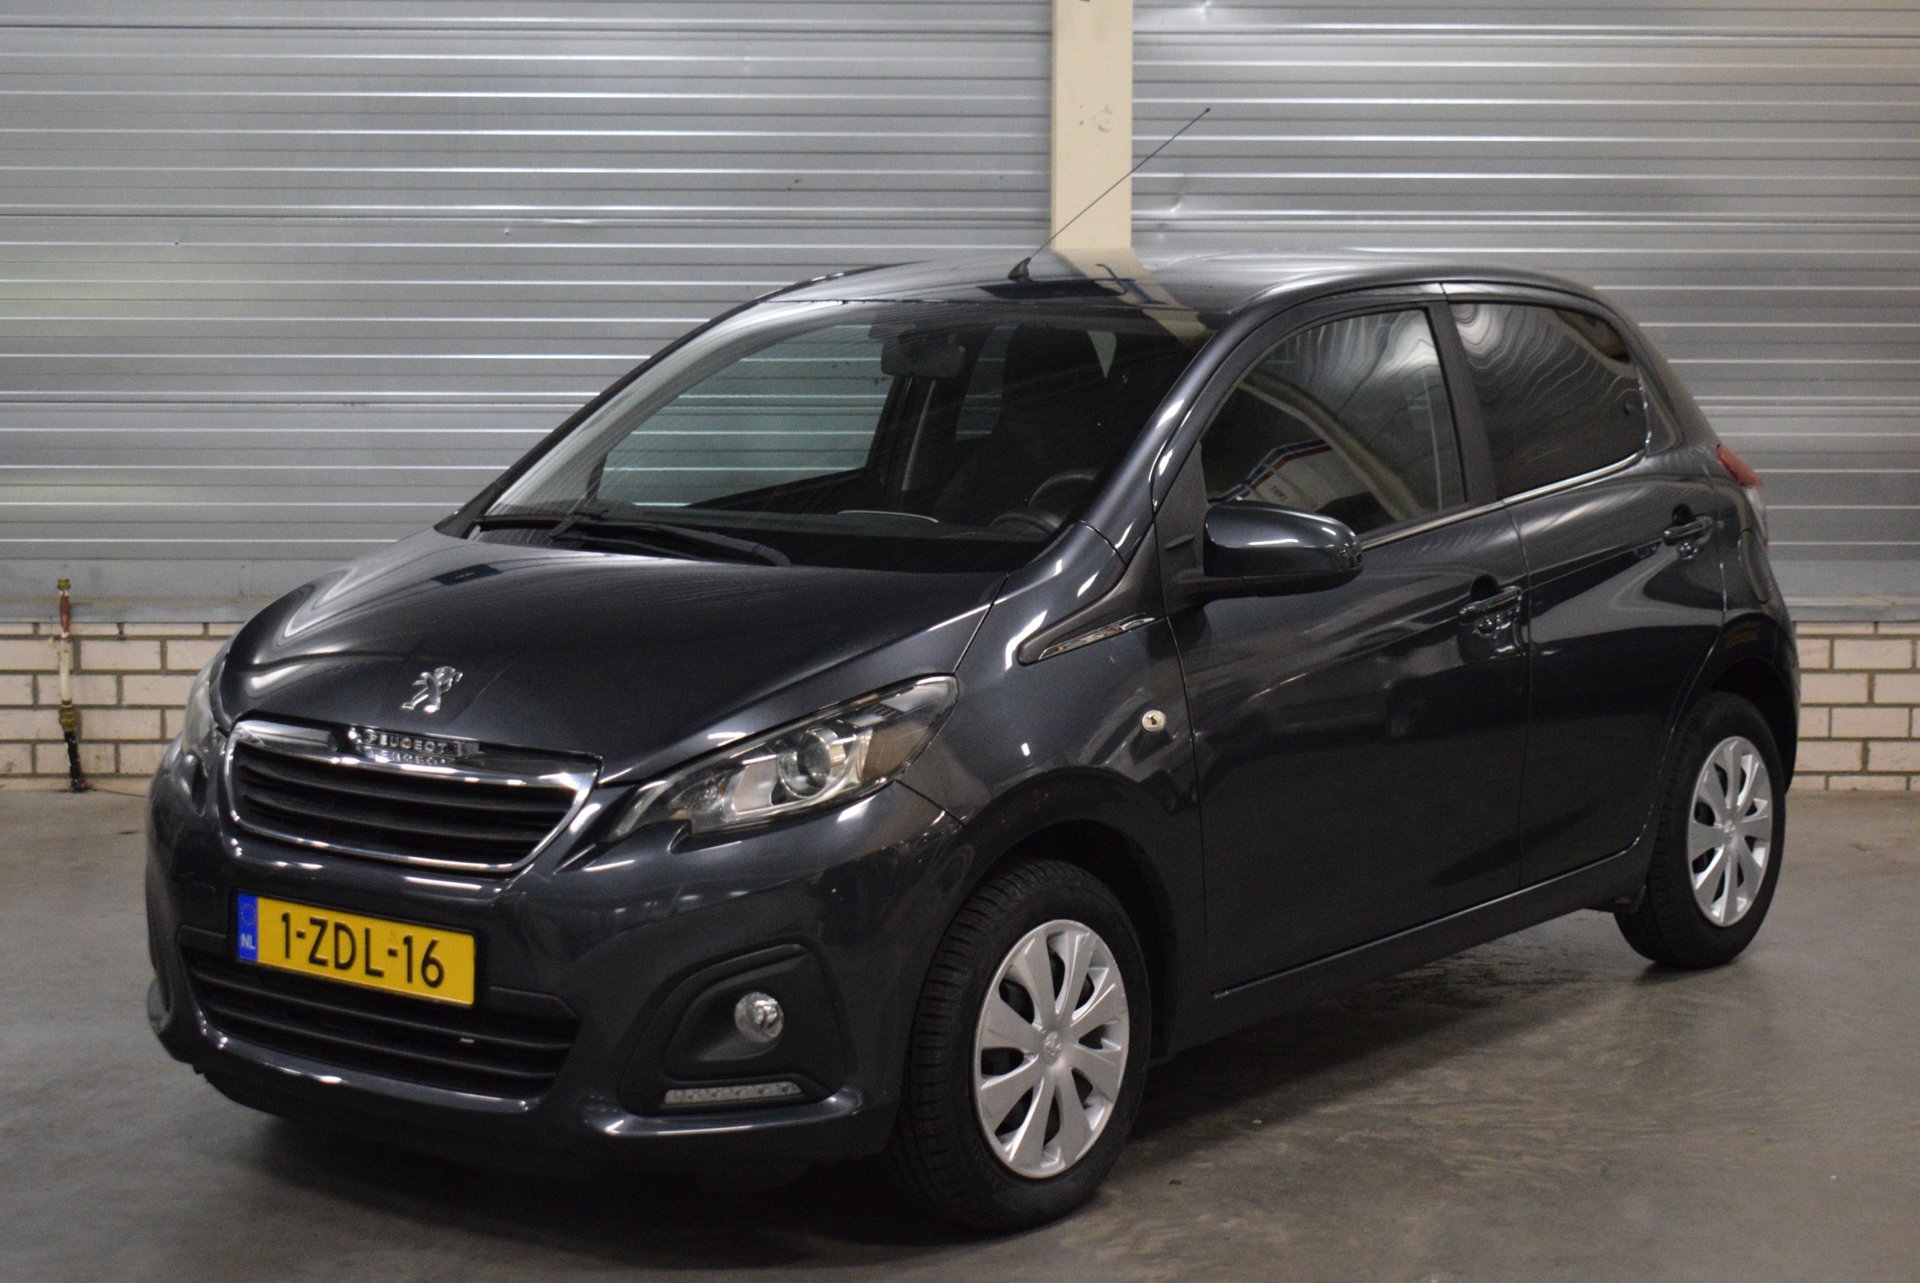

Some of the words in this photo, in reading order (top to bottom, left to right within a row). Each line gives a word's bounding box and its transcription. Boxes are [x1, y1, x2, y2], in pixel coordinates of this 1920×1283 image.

[366, 731, 447, 753] PEUGEOT
[240, 933, 256, 950] NL
[281, 911, 444, 988] 1-ZDL-16
